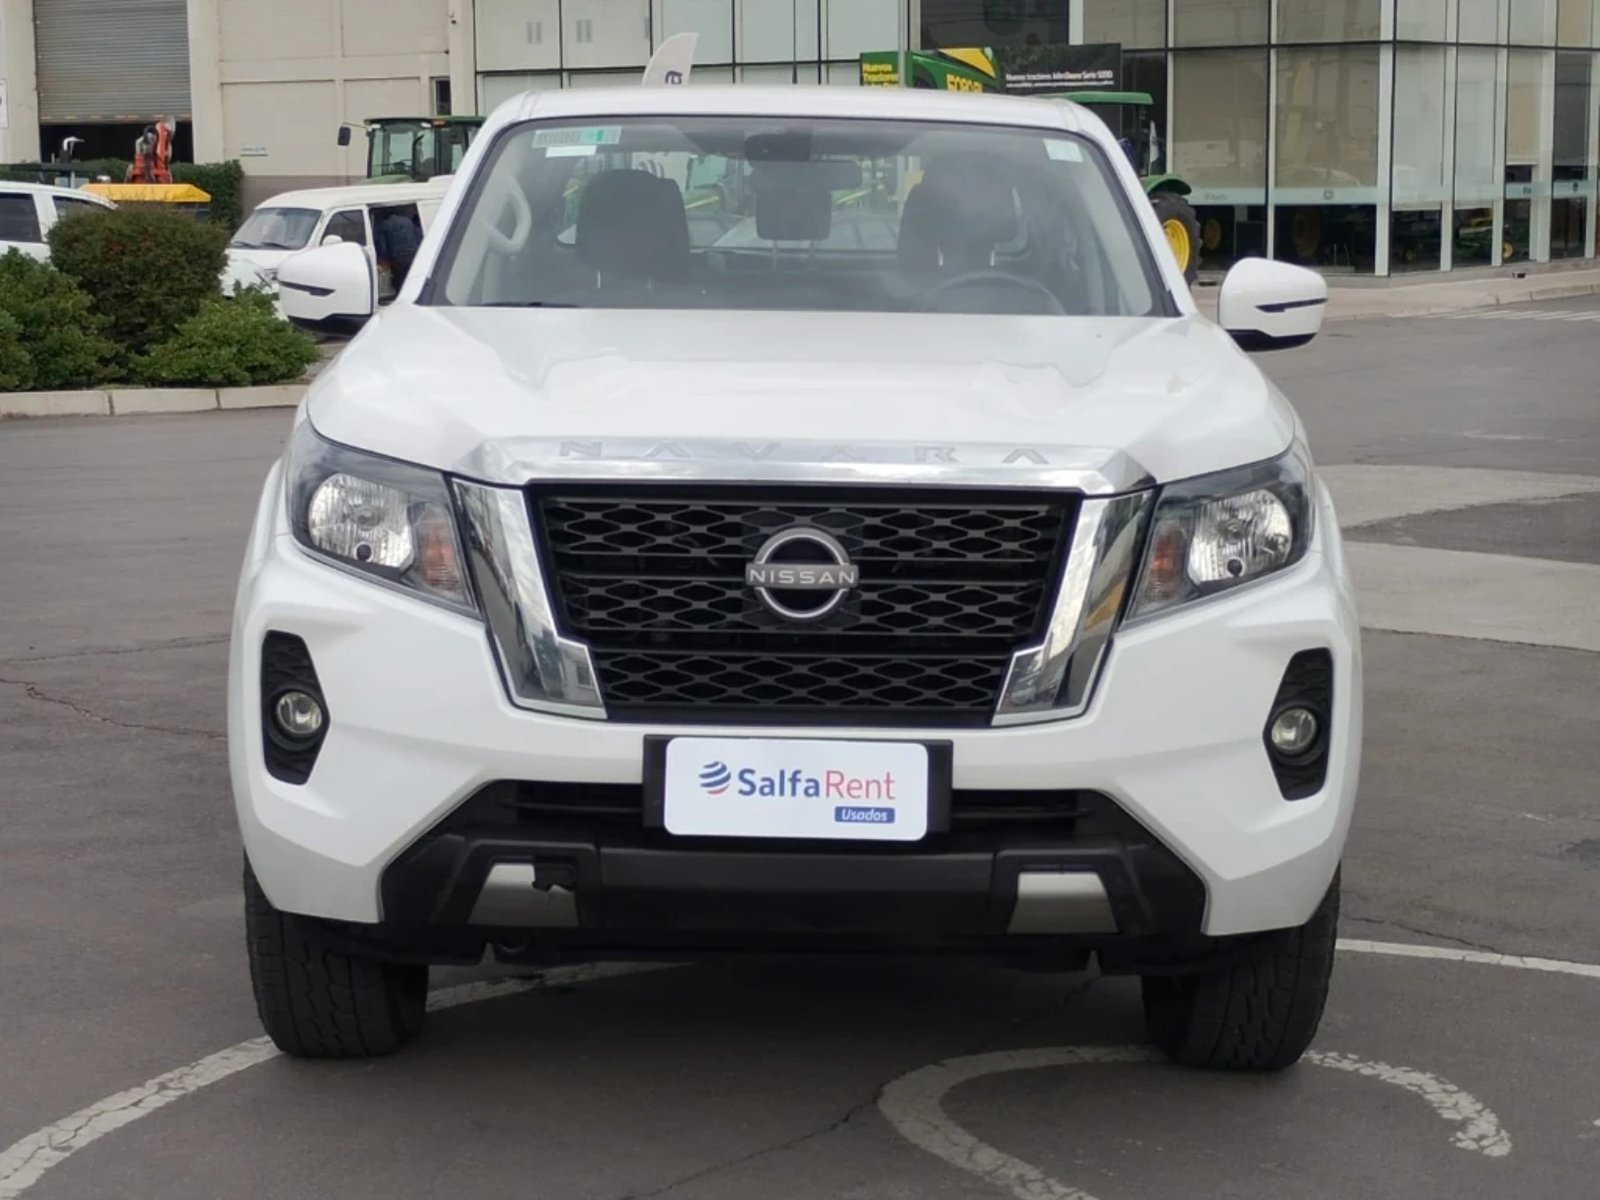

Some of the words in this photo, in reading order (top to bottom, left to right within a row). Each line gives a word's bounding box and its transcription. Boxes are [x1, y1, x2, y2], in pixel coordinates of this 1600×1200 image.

[559, 440, 1050, 465] NAVARA
[749, 568, 854, 584] NISSAN
[841, 808, 888, 822] Usados
